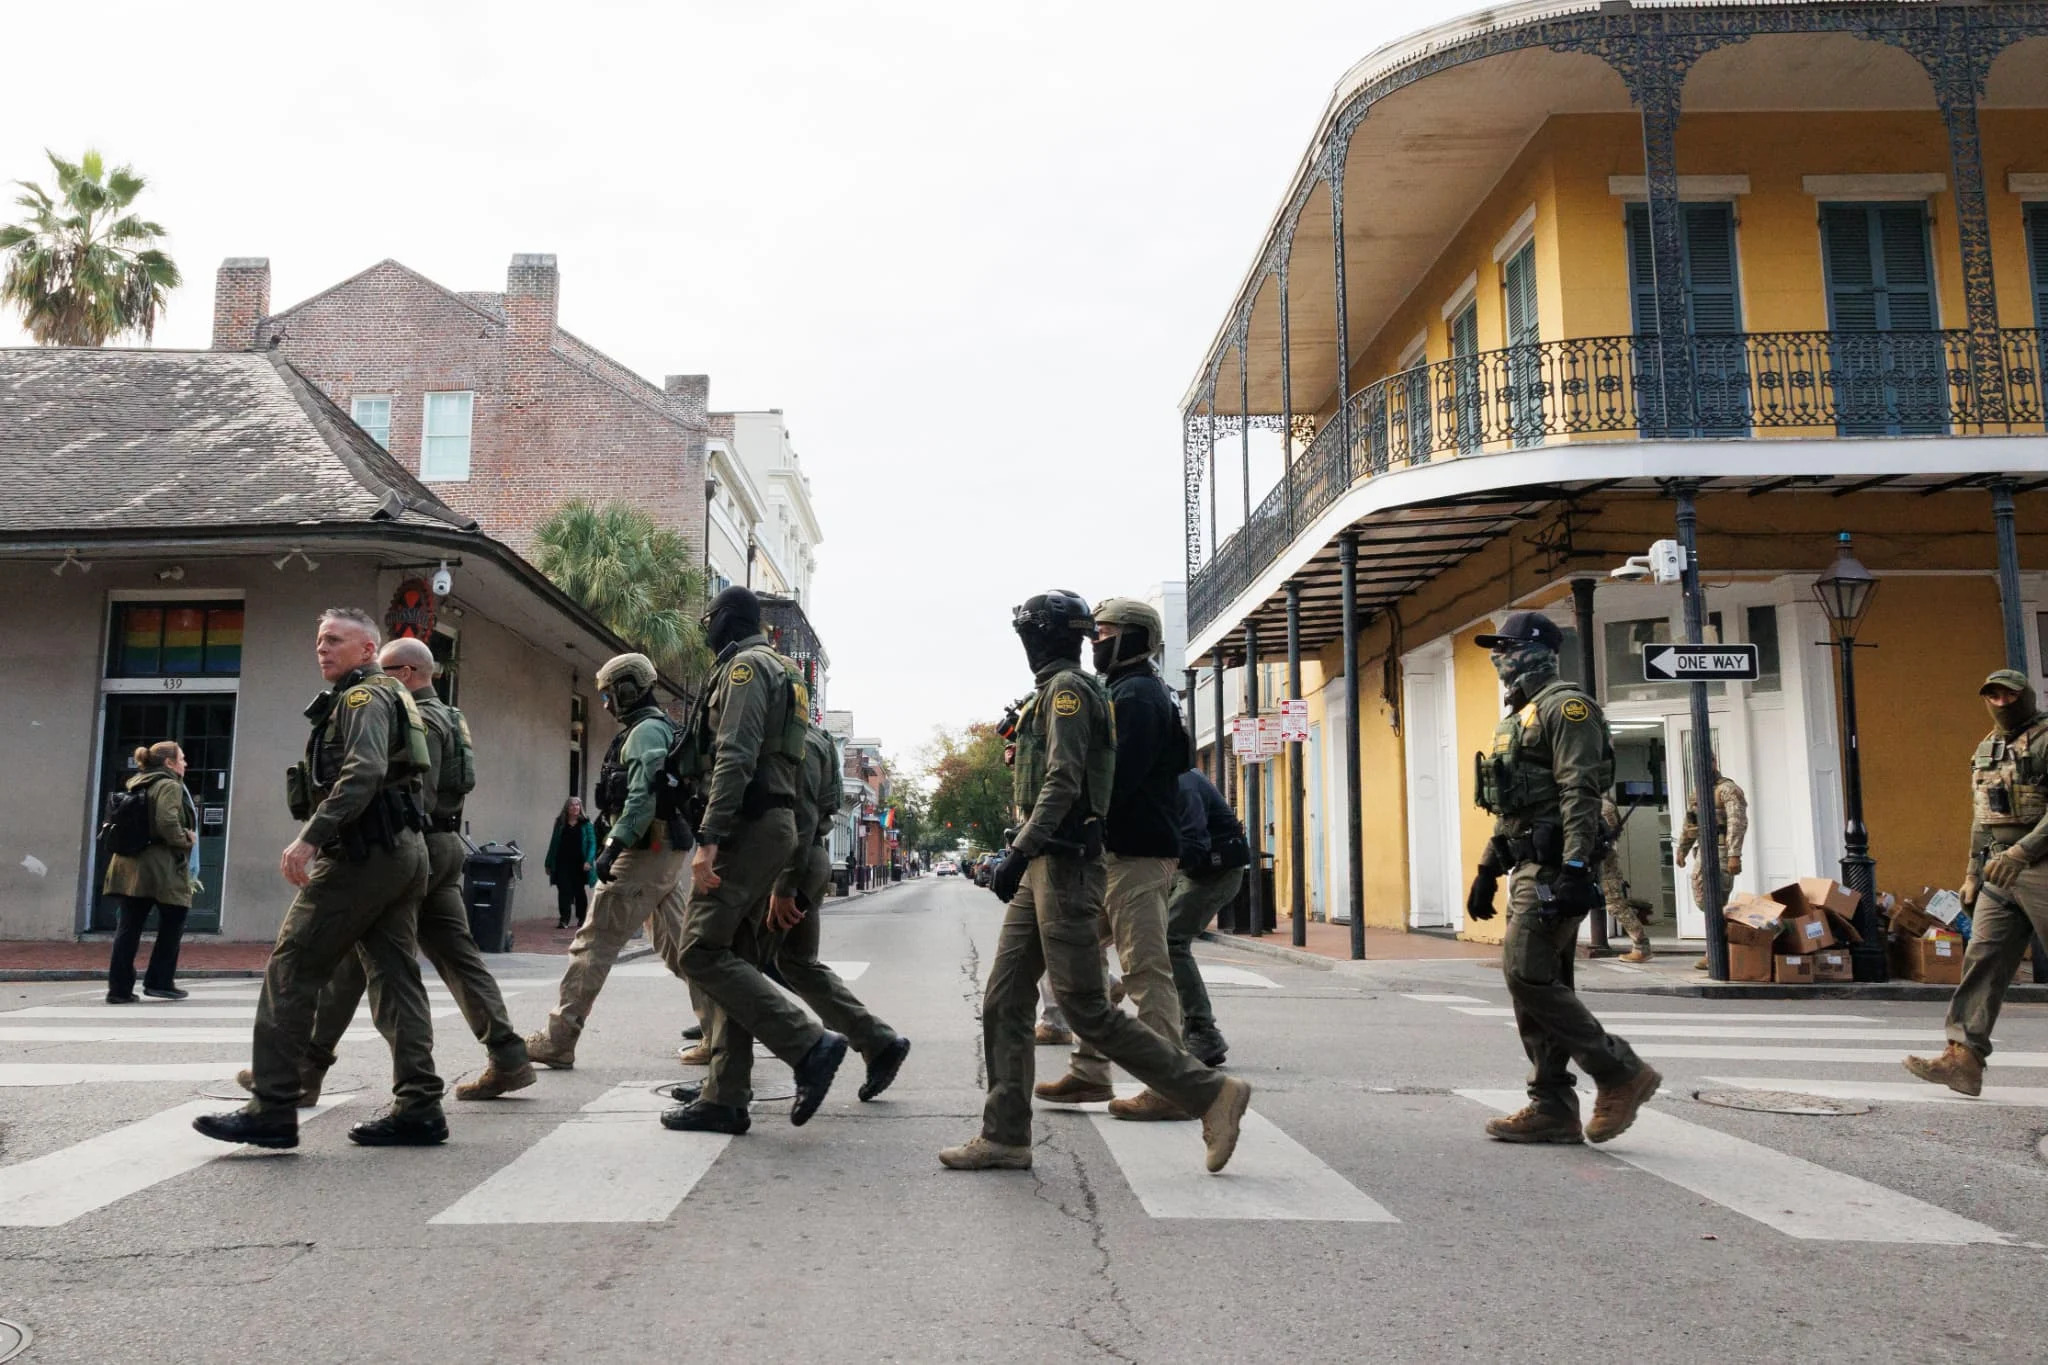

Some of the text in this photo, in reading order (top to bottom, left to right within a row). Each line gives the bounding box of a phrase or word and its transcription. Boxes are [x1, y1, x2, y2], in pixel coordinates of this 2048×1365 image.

[1677, 655, 1744, 670] ONE WAY
[163, 678, 183, 689] 439
